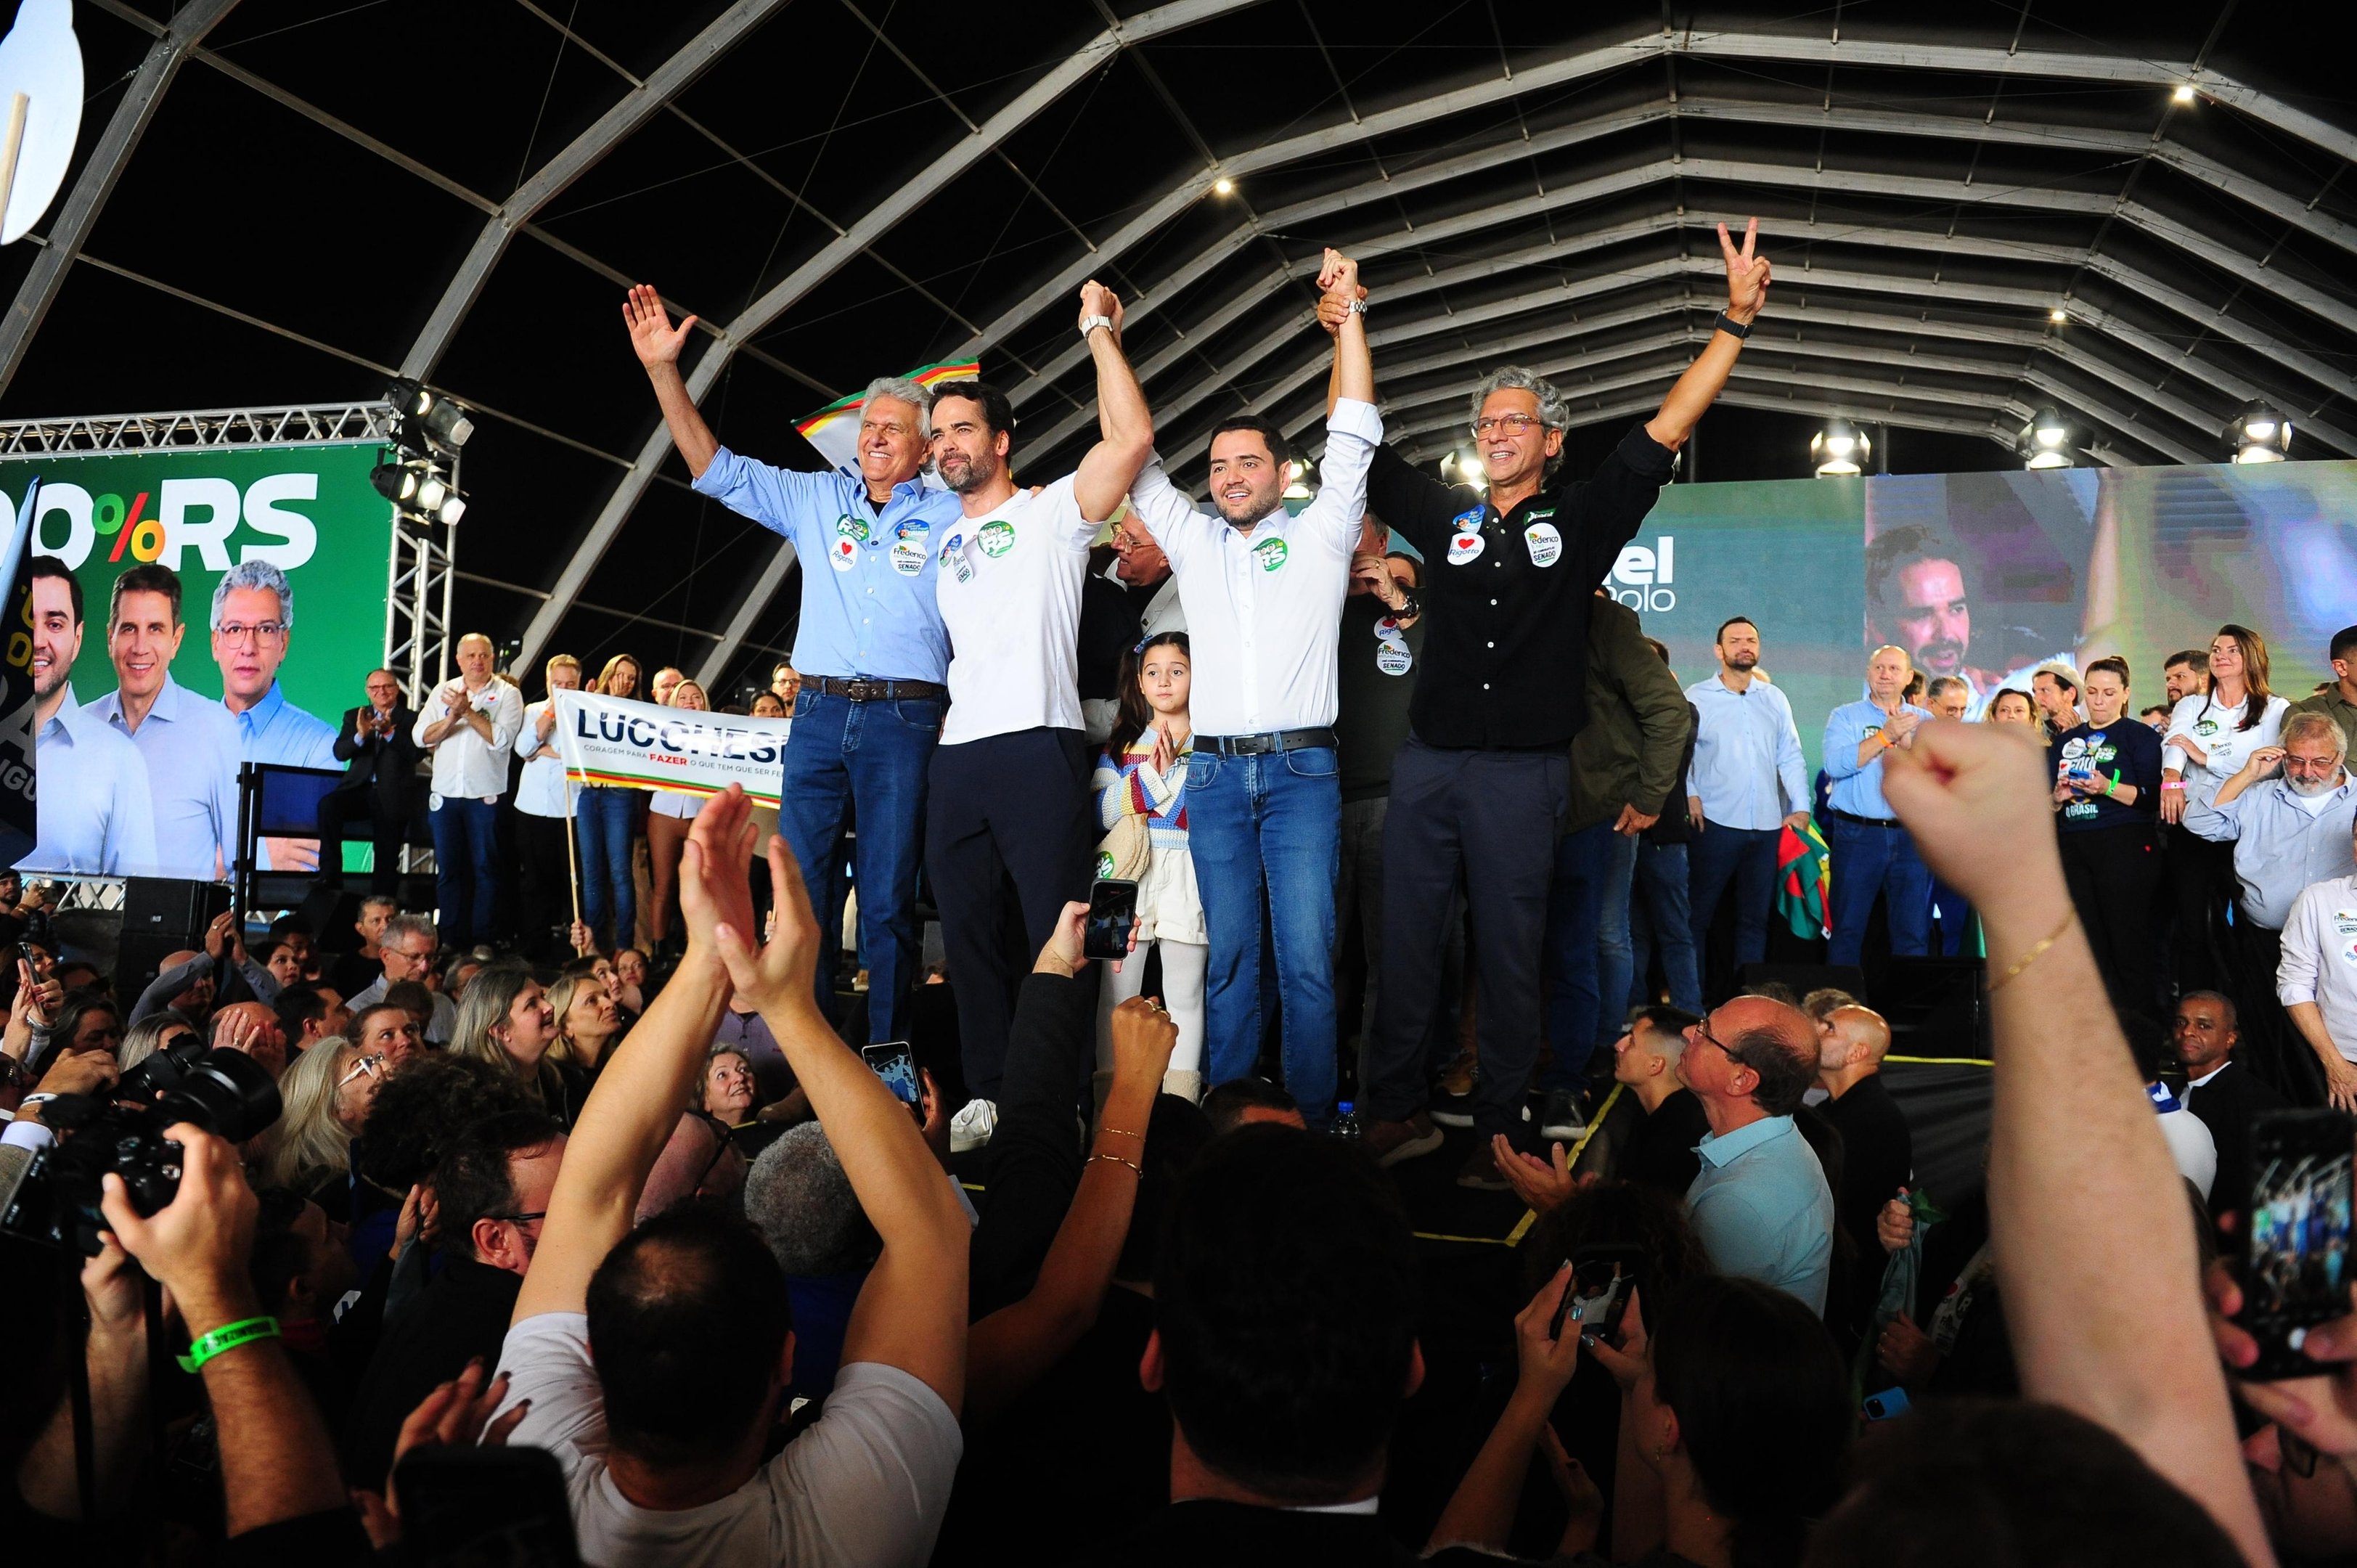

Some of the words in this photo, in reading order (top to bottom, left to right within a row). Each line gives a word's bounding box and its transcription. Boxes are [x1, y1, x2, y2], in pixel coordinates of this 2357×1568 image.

[0, 473, 318, 572] 0%RS
[1529, 535, 1559, 544] ederico
[832, 550, 854, 565] Rigotto
[1449, 549, 1479, 558] Rigotto
[1533, 550, 1556, 561] SENADO
[1601, 536, 1674, 585] el
[1378, 648, 1410, 658] Frederico
[584, 744, 625, 755] CORAGEM
[649, 754, 687, 766] FAZER
[2070, 804, 2099, 816] BRASIL
